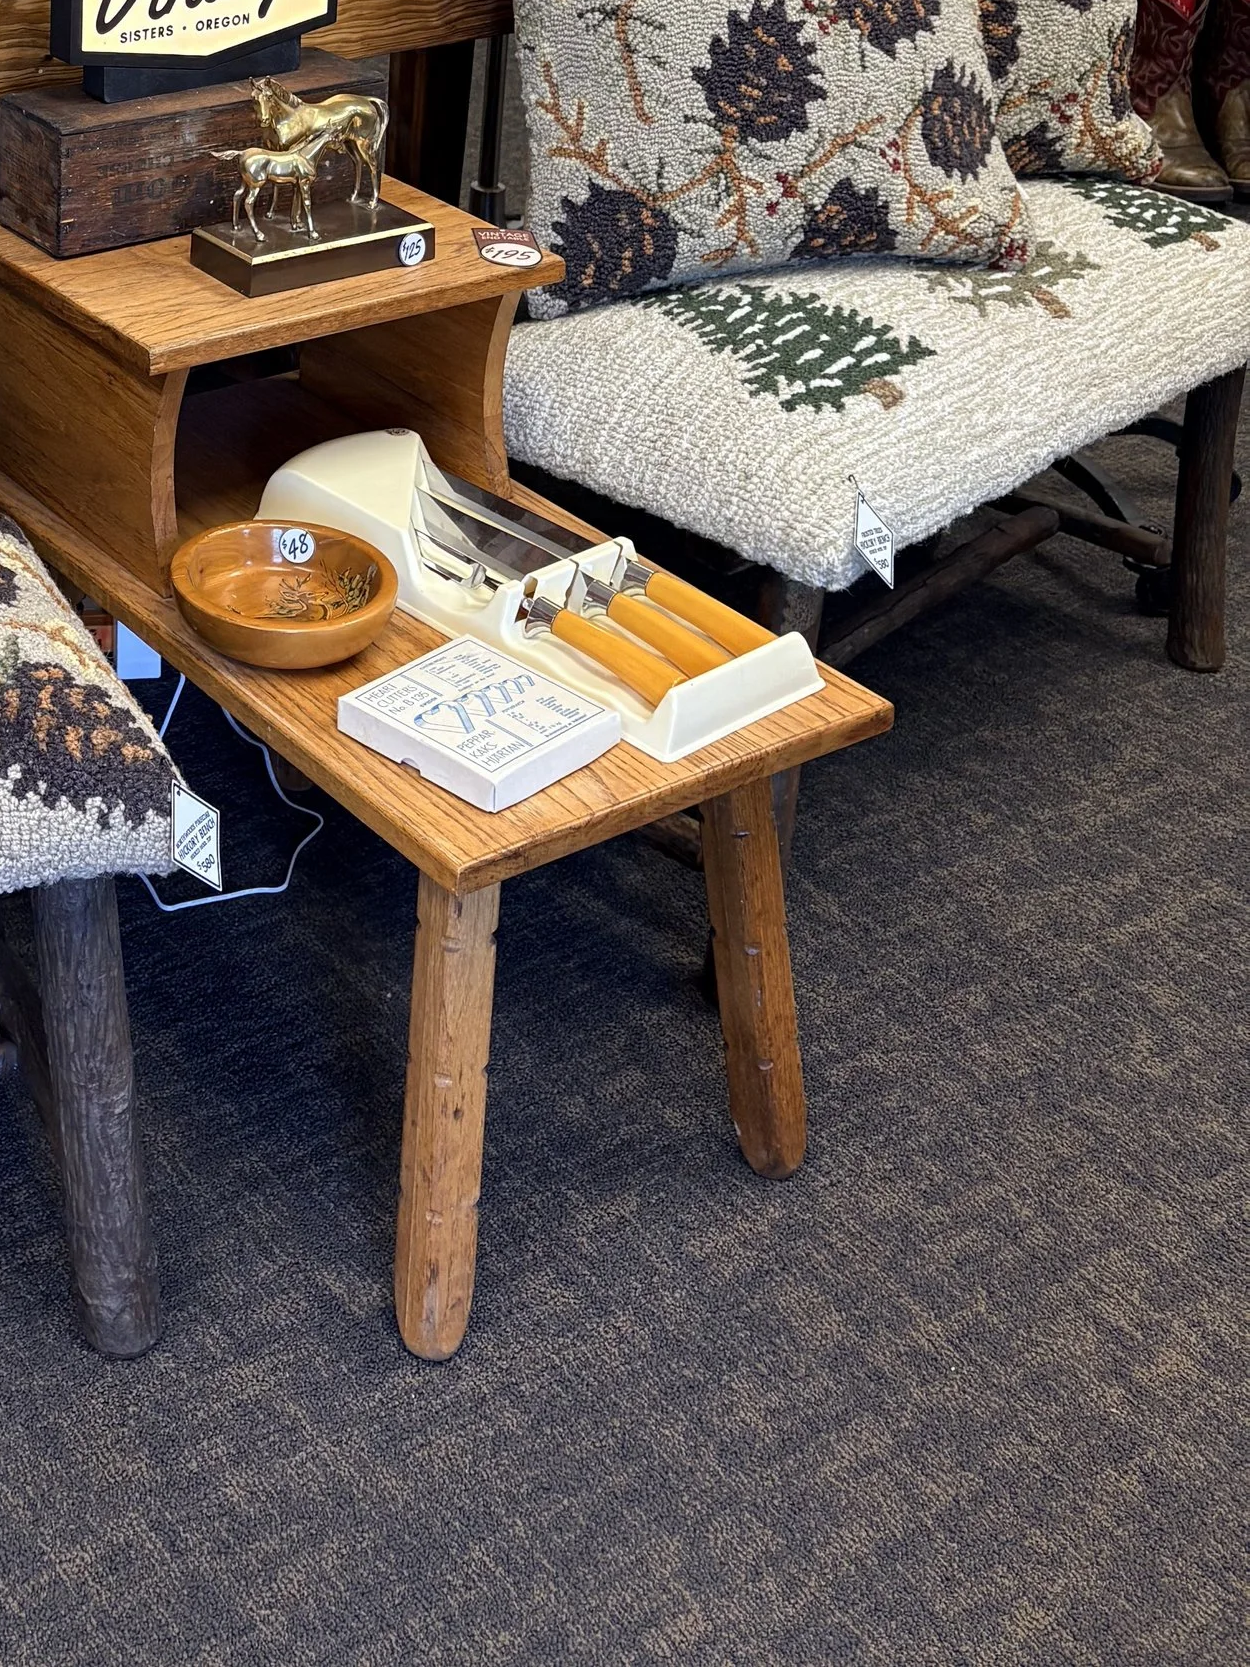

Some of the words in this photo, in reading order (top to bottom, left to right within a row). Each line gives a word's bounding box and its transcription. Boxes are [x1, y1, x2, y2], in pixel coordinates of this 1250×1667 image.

[119, 24, 174, 44] SISTERS
[195, 13, 250, 32] OREGON
[402, 238, 421, 261] $125
[484, 246, 535, 260] $195
[282, 531, 310, 559] $48
[364, 683, 397, 702] HEART
[377, 685, 418, 707] CUTTERS
[411, 690, 430, 702] 135
[178, 833, 200, 861] HICKORY
[198, 817, 216, 840] BENCH
[197, 853, 216, 873] $580
